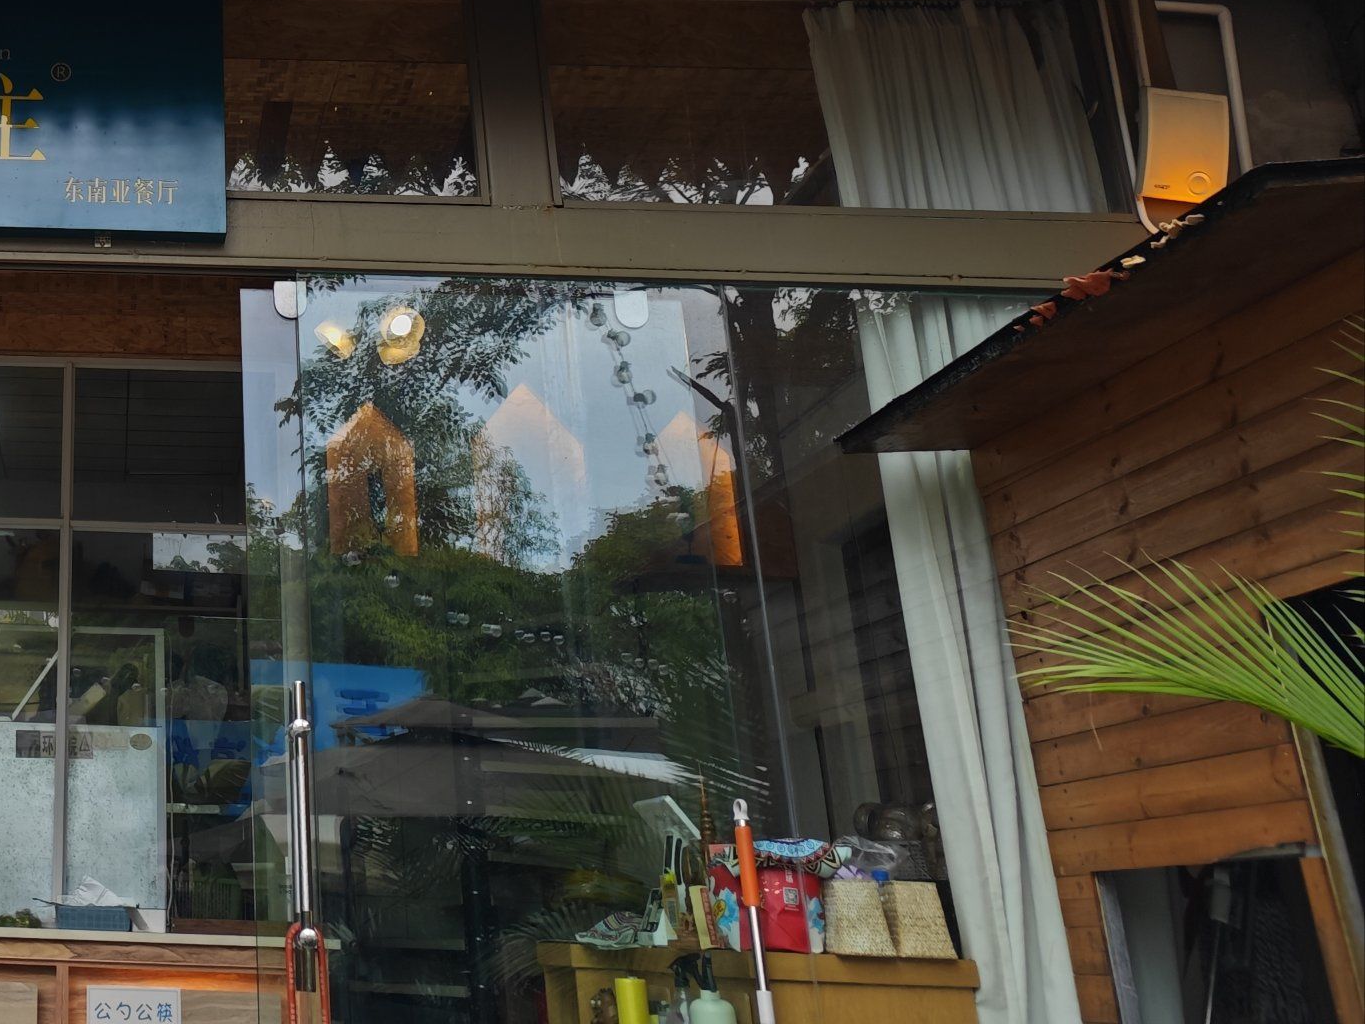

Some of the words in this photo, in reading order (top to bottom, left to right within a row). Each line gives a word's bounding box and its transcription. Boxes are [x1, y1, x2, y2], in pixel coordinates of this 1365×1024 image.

[64, 176, 179, 205] 东南亚餐厅
[94, 1001, 173, 1023] 公勺公筷
